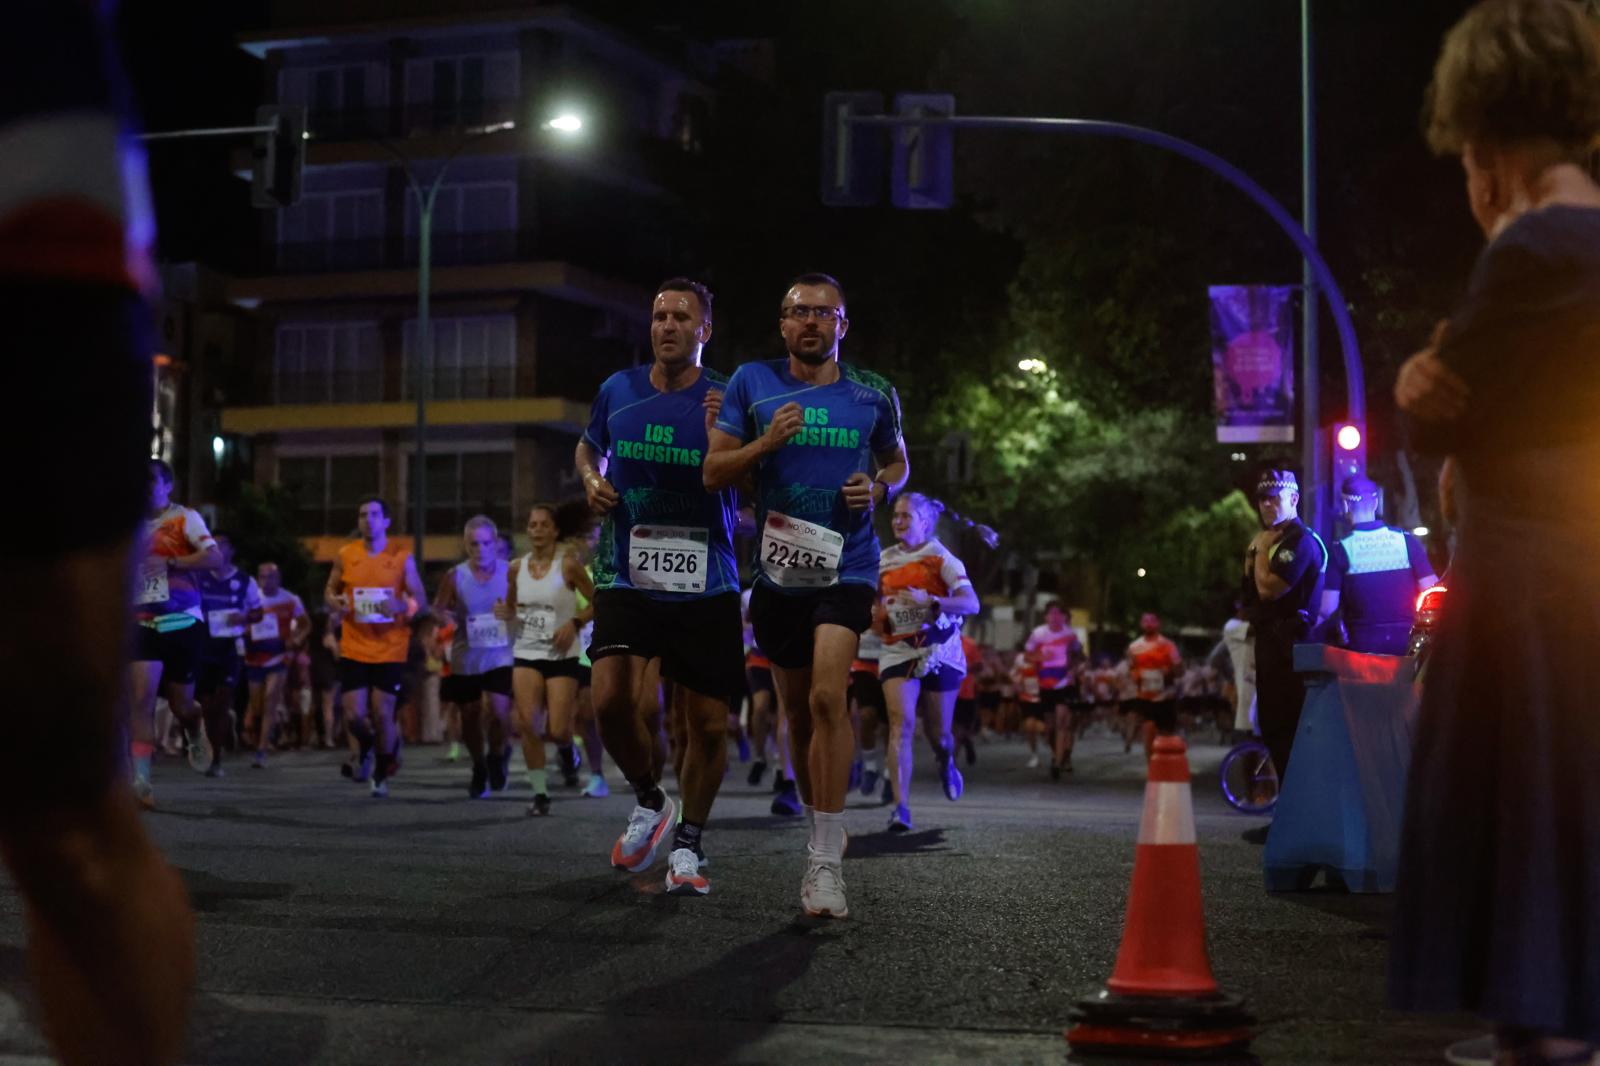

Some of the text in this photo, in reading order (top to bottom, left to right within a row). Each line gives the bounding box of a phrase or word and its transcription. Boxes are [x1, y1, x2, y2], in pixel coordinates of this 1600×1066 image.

[801, 407, 829, 425] OS
[644, 423, 674, 445] LOS
[763, 423, 860, 449] USITAS
[617, 439, 702, 467] EXCUSITAS
[637, 551, 697, 575] 21526
[766, 541, 827, 570] 22435
